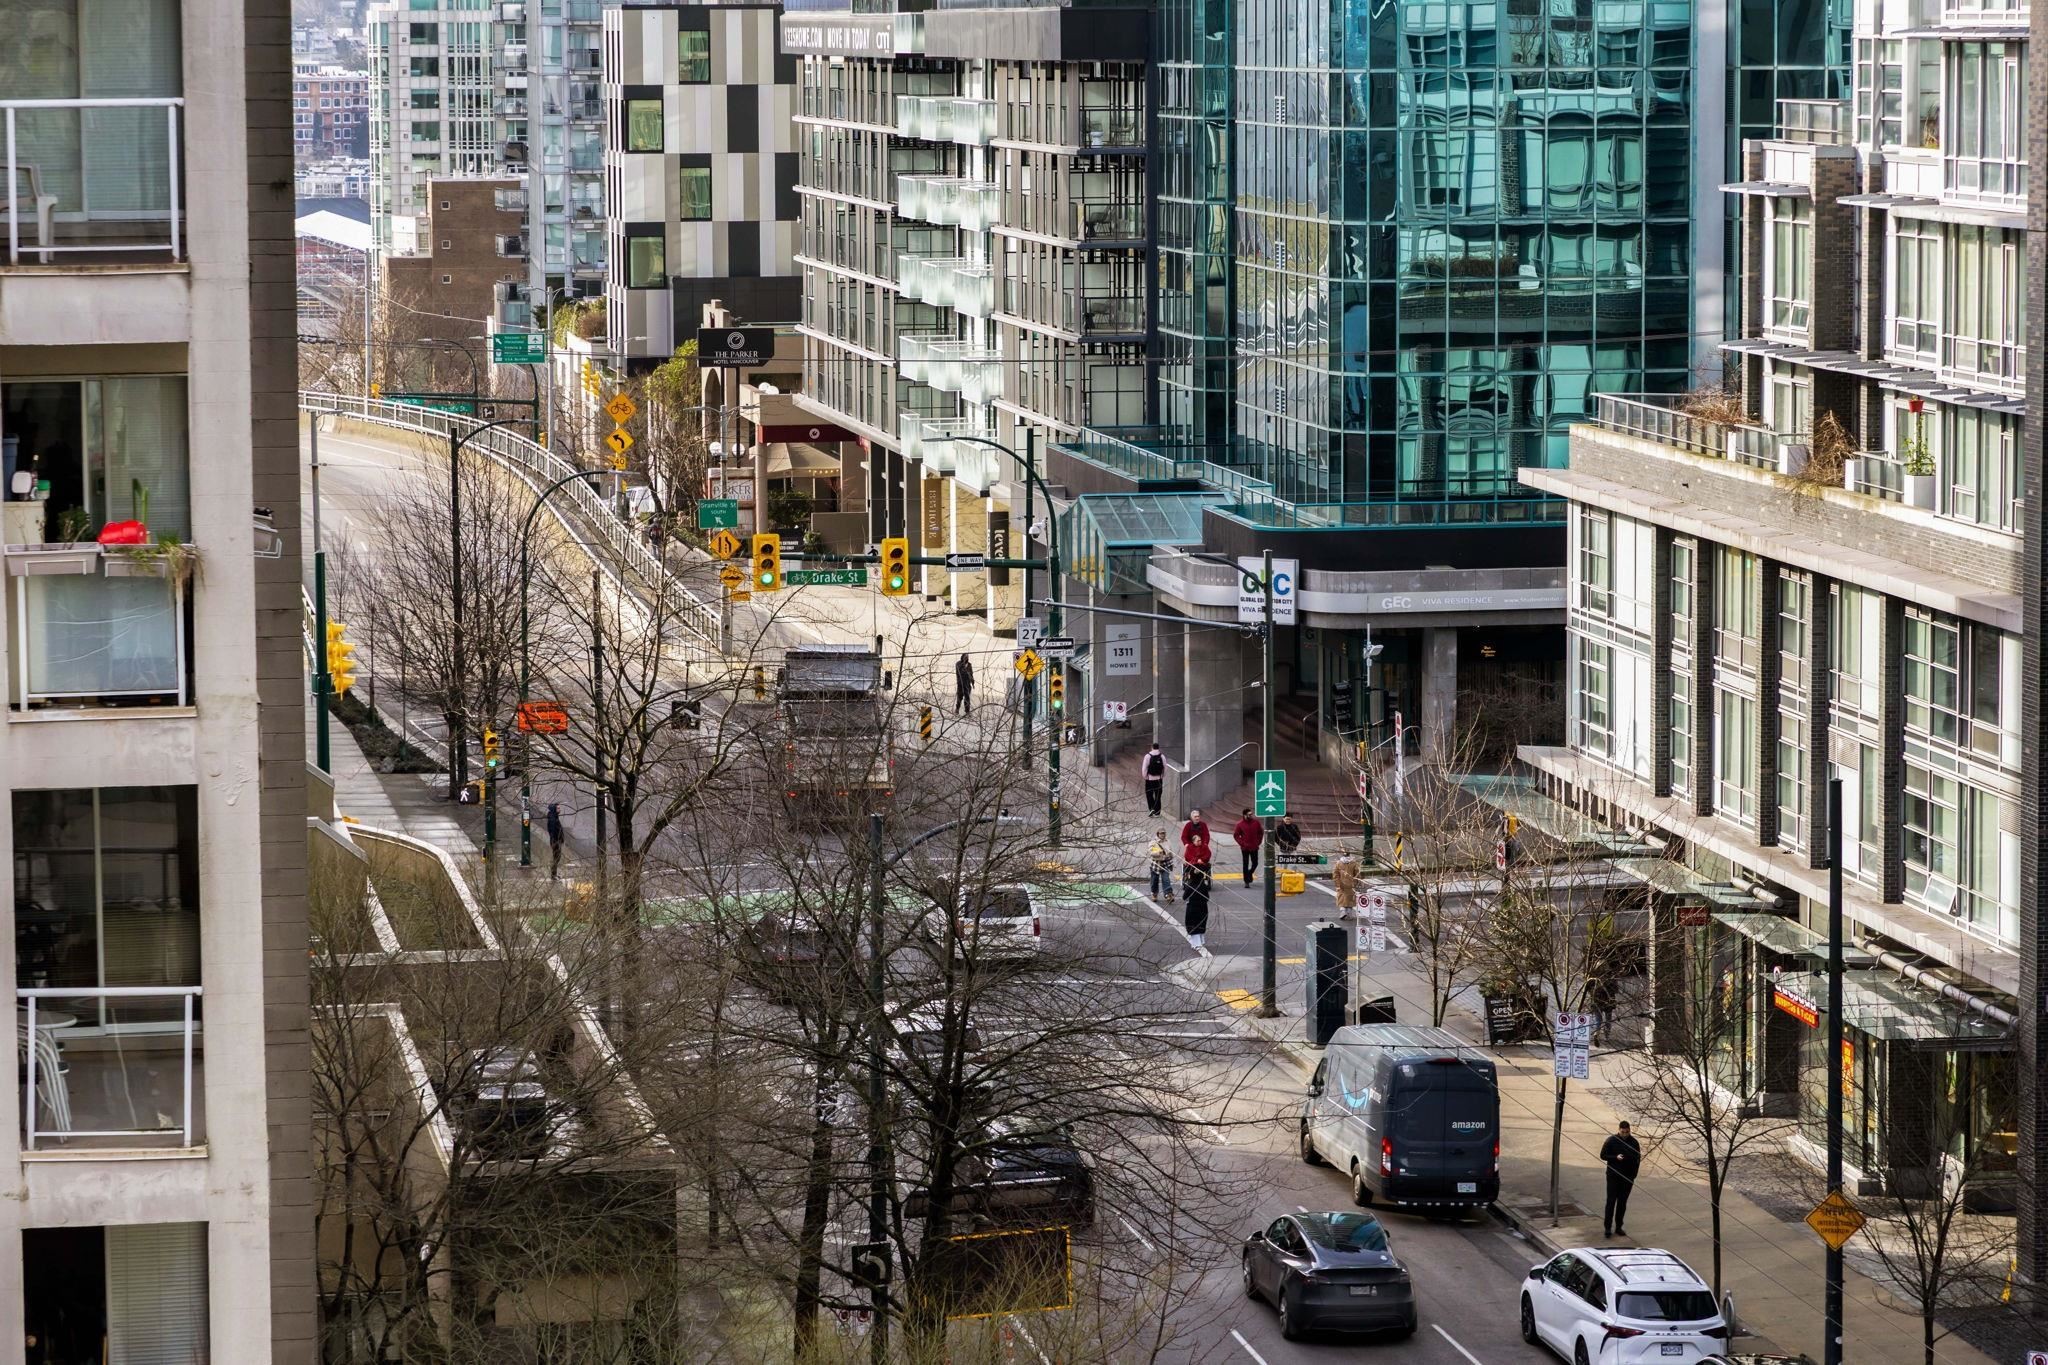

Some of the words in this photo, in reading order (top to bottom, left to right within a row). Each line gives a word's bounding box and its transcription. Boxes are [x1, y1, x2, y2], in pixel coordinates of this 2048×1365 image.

[827, 27, 843, 49] MOVE
[843, 27, 850, 49] IN
[851, 27, 871, 50] TODAY
[715, 350, 729, 358] THE
[730, 350, 758, 358] PARKER
[957, 556, 969, 564] ONE
[812, 572, 843, 583] Drake
[848, 571, 859, 582] St
[1382, 596, 1411, 609] GEC
[1422, 597, 1442, 605] VIVA
[1444, 596, 1493, 605] RESIDENCE
[1022, 629, 1037, 640] 27
[1113, 647, 1133, 657] 1311
[1492, 1007, 1512, 1017] OPEN
[1451, 1121, 1486, 1129] amazon
